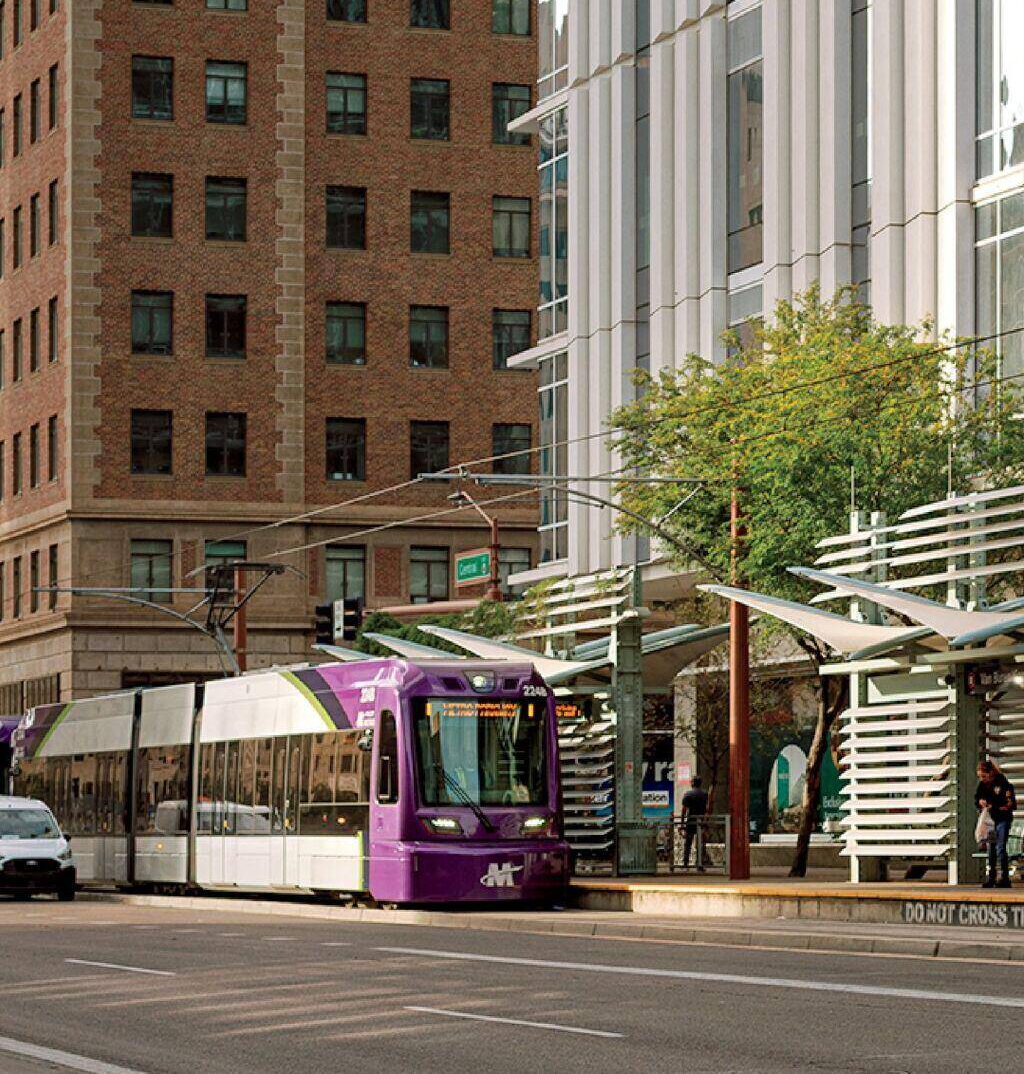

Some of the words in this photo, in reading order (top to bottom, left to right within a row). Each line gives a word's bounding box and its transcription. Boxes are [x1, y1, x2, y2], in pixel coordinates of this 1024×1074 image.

[905, 902, 924, 923] DO
[926, 903, 955, 924] NOT
[958, 904, 1007, 926] CROSS
